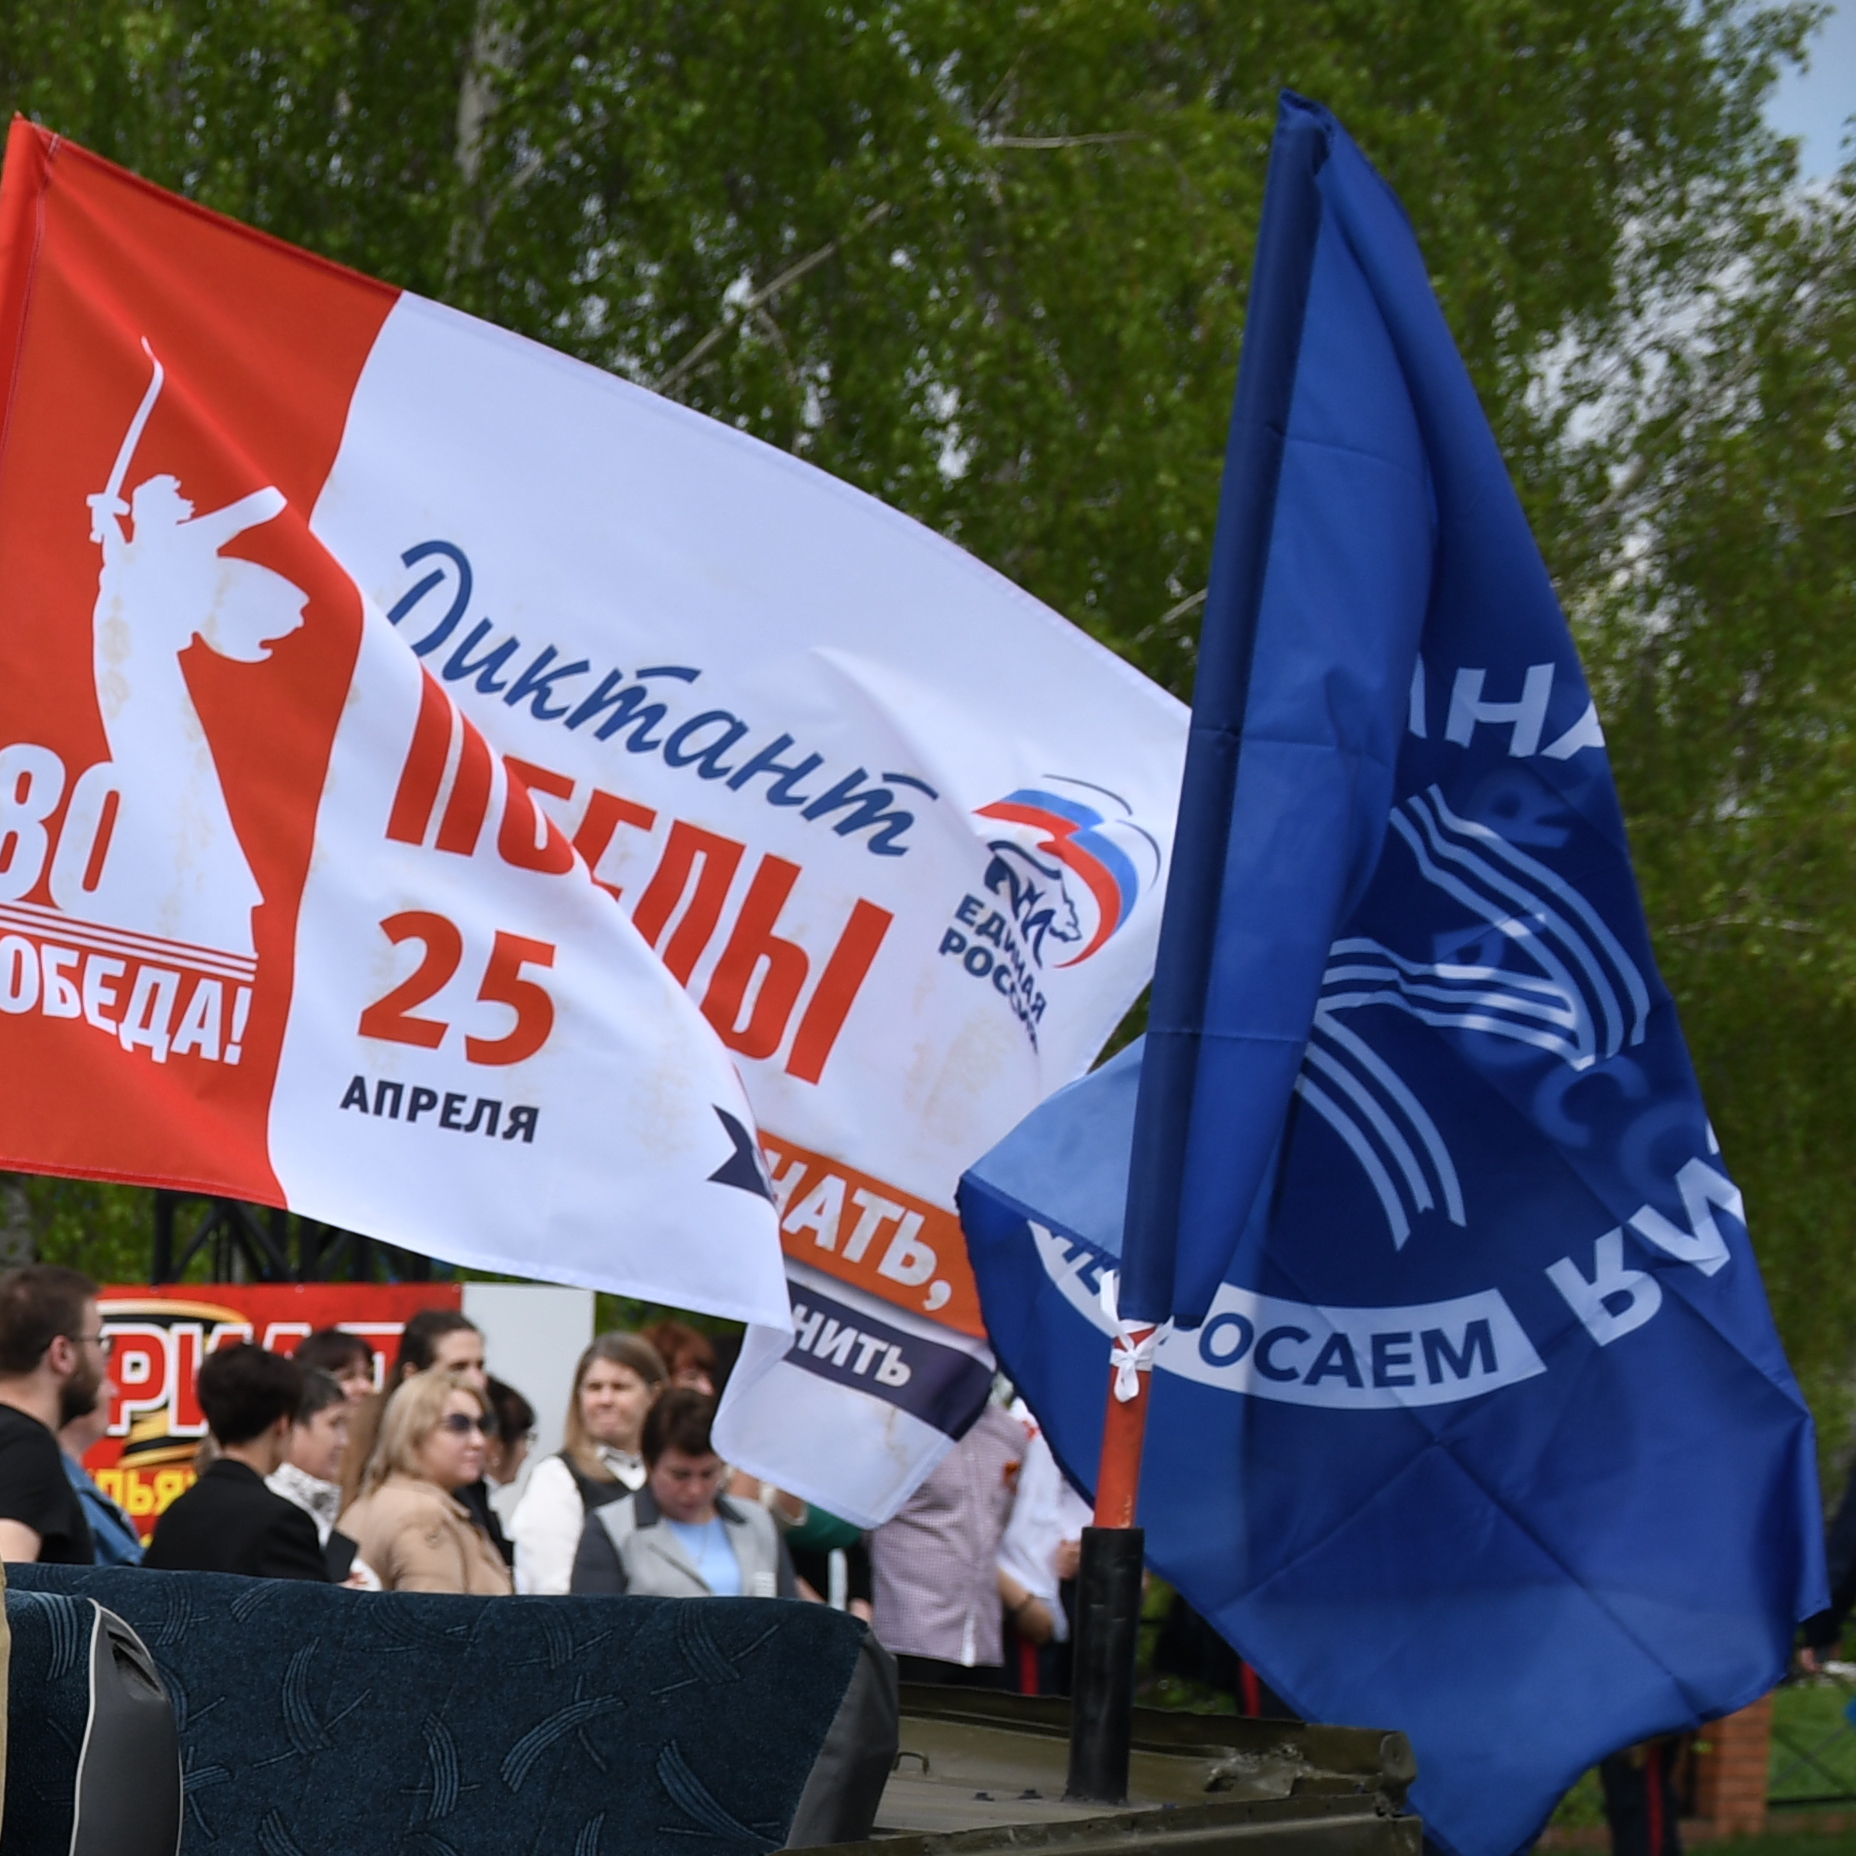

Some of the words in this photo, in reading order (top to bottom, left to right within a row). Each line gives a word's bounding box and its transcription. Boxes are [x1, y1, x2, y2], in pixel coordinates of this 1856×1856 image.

[385, 538, 940, 858] Диктант
[357, 909, 557, 1067] 25
[339, 1074, 541, 1144] АПРЕЛЯ
[1196, 1312, 1499, 1390] ОСАЕМ
